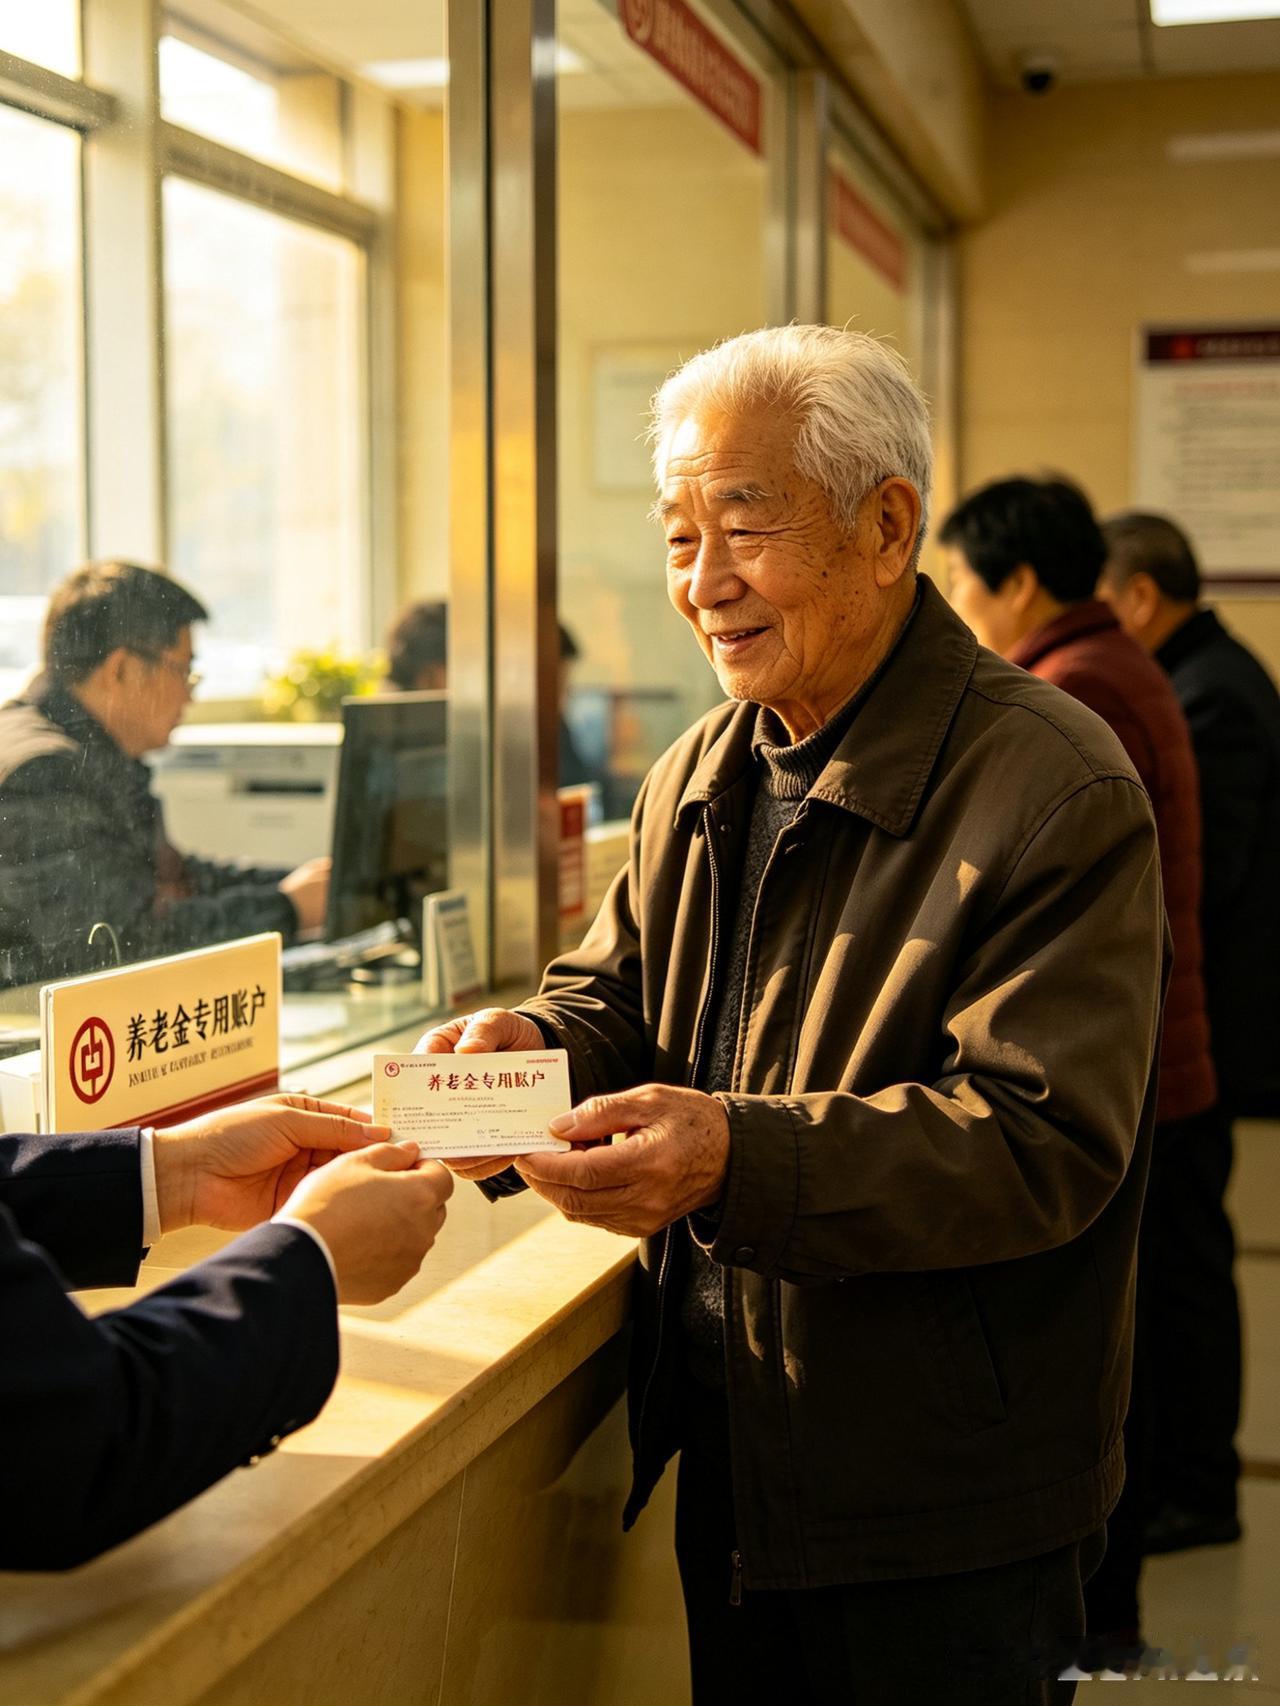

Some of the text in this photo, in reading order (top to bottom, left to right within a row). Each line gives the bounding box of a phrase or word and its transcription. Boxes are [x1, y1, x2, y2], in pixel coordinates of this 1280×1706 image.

[126, 985, 266, 1062] 养老金专用账户
